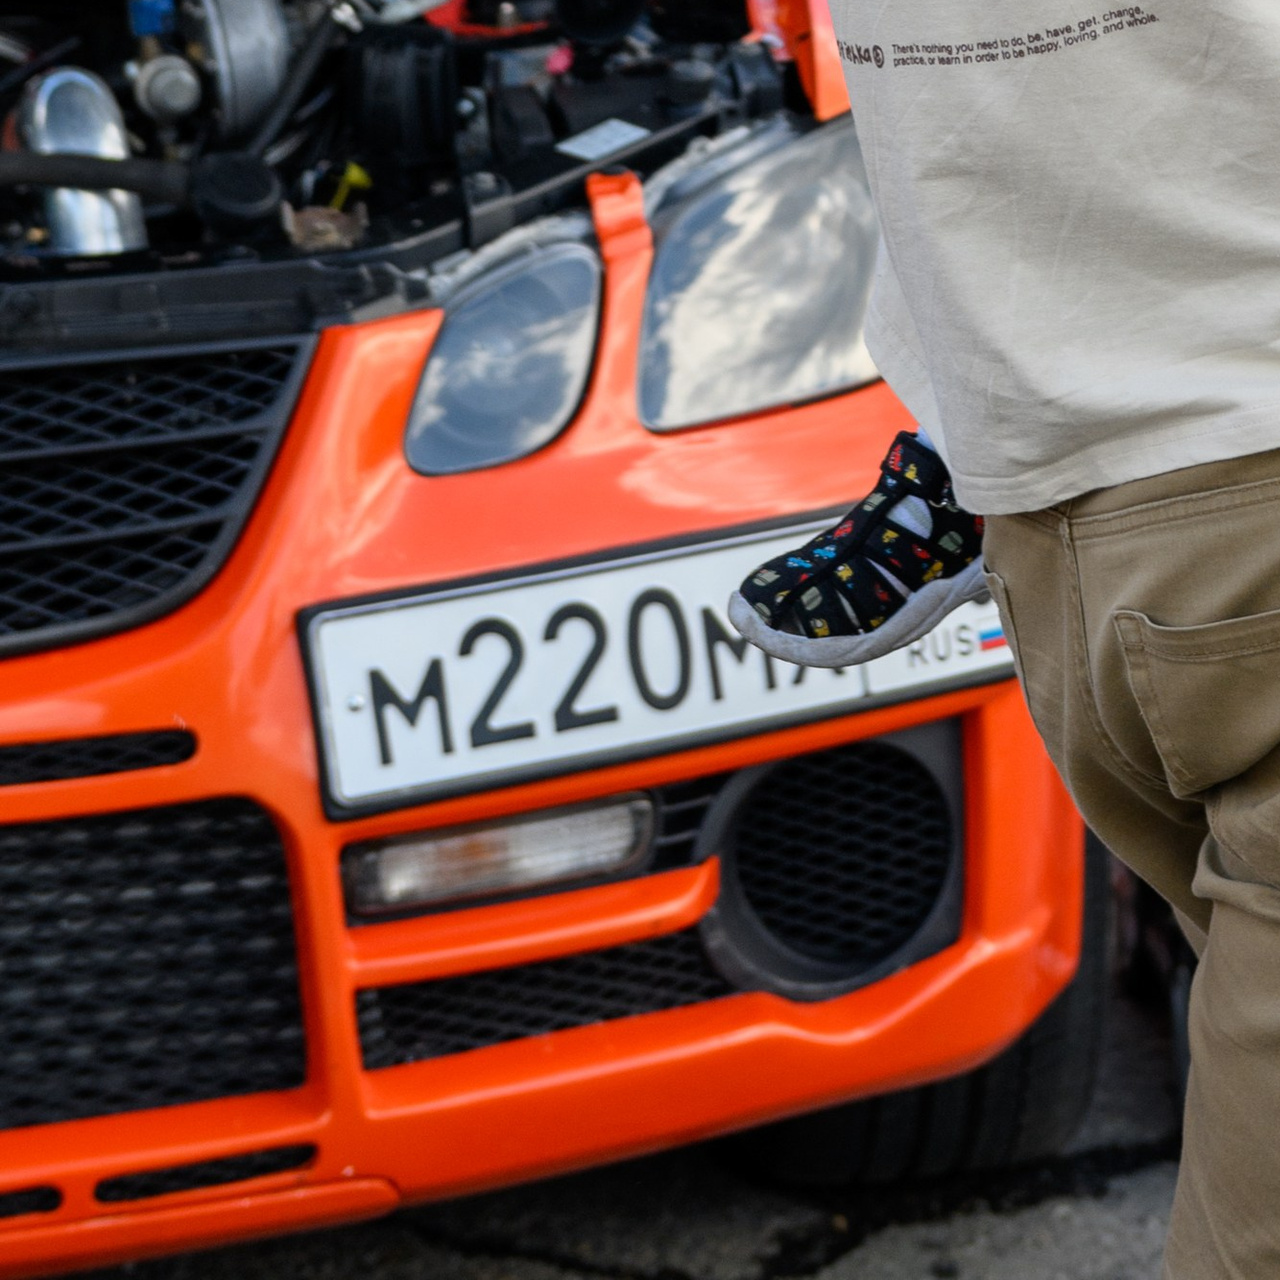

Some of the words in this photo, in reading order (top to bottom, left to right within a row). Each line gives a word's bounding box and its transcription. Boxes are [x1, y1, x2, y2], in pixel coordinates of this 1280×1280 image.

[892, 43, 921, 54] There's
[922, 43, 953, 55] nothing
[955, 43, 974, 54] you
[977, 38, 999, 50] need
[1000, 38, 1010, 48] to
[928, 57, 936, 66] or
[937, 55, 961, 66] learn
[963, 53, 972, 64] in
[975, 51, 999, 63] order
[1001, 50, 1011, 60] to
[1013, 48, 1025, 58] be
[1102, 20, 1124, 34] and
[907, 624, 974, 669] RUS
